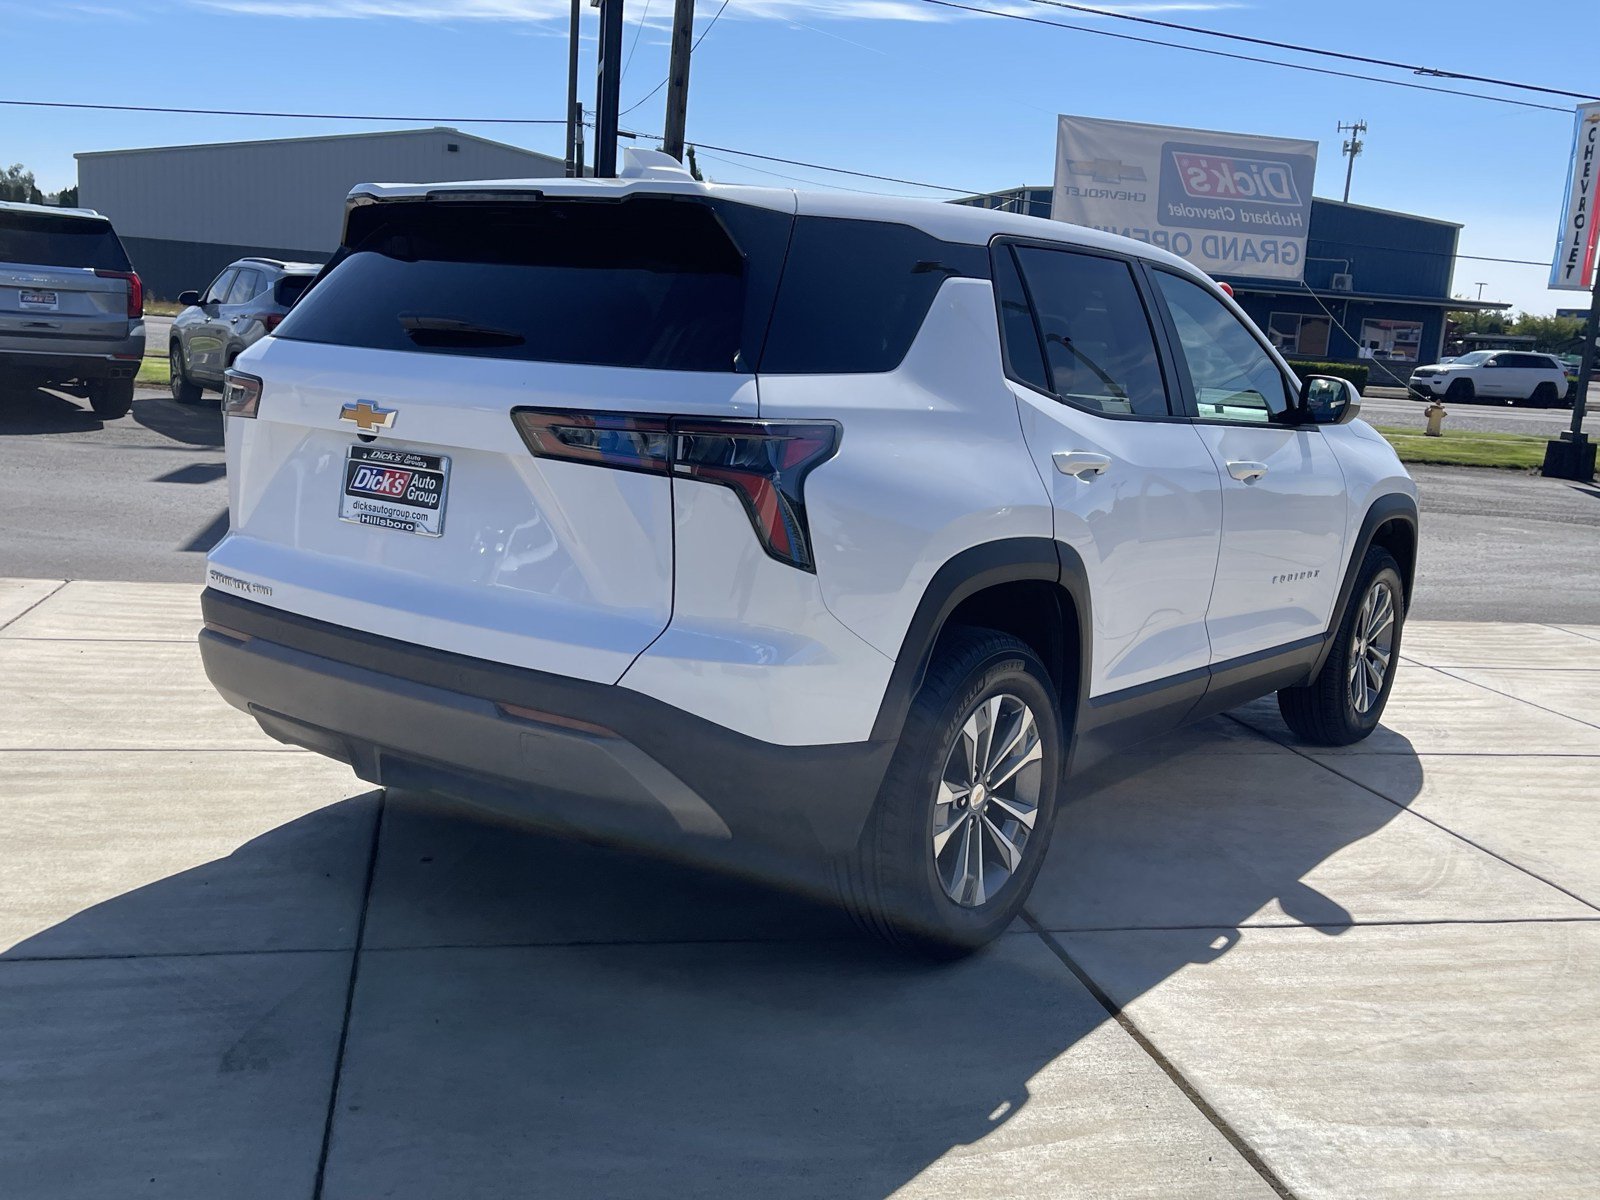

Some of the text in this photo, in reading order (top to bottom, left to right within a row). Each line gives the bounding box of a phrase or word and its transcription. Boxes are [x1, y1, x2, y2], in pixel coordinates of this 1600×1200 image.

[1565, 127, 1597, 279] CHEVROLET
[371, 451, 402, 462] Dick's
[354, 468, 436, 493] Dick's Auto
[407, 487, 438, 506] Group
[353, 500, 428, 521] dicksautogroup.com
[361, 514, 414, 531] Hillsboro
